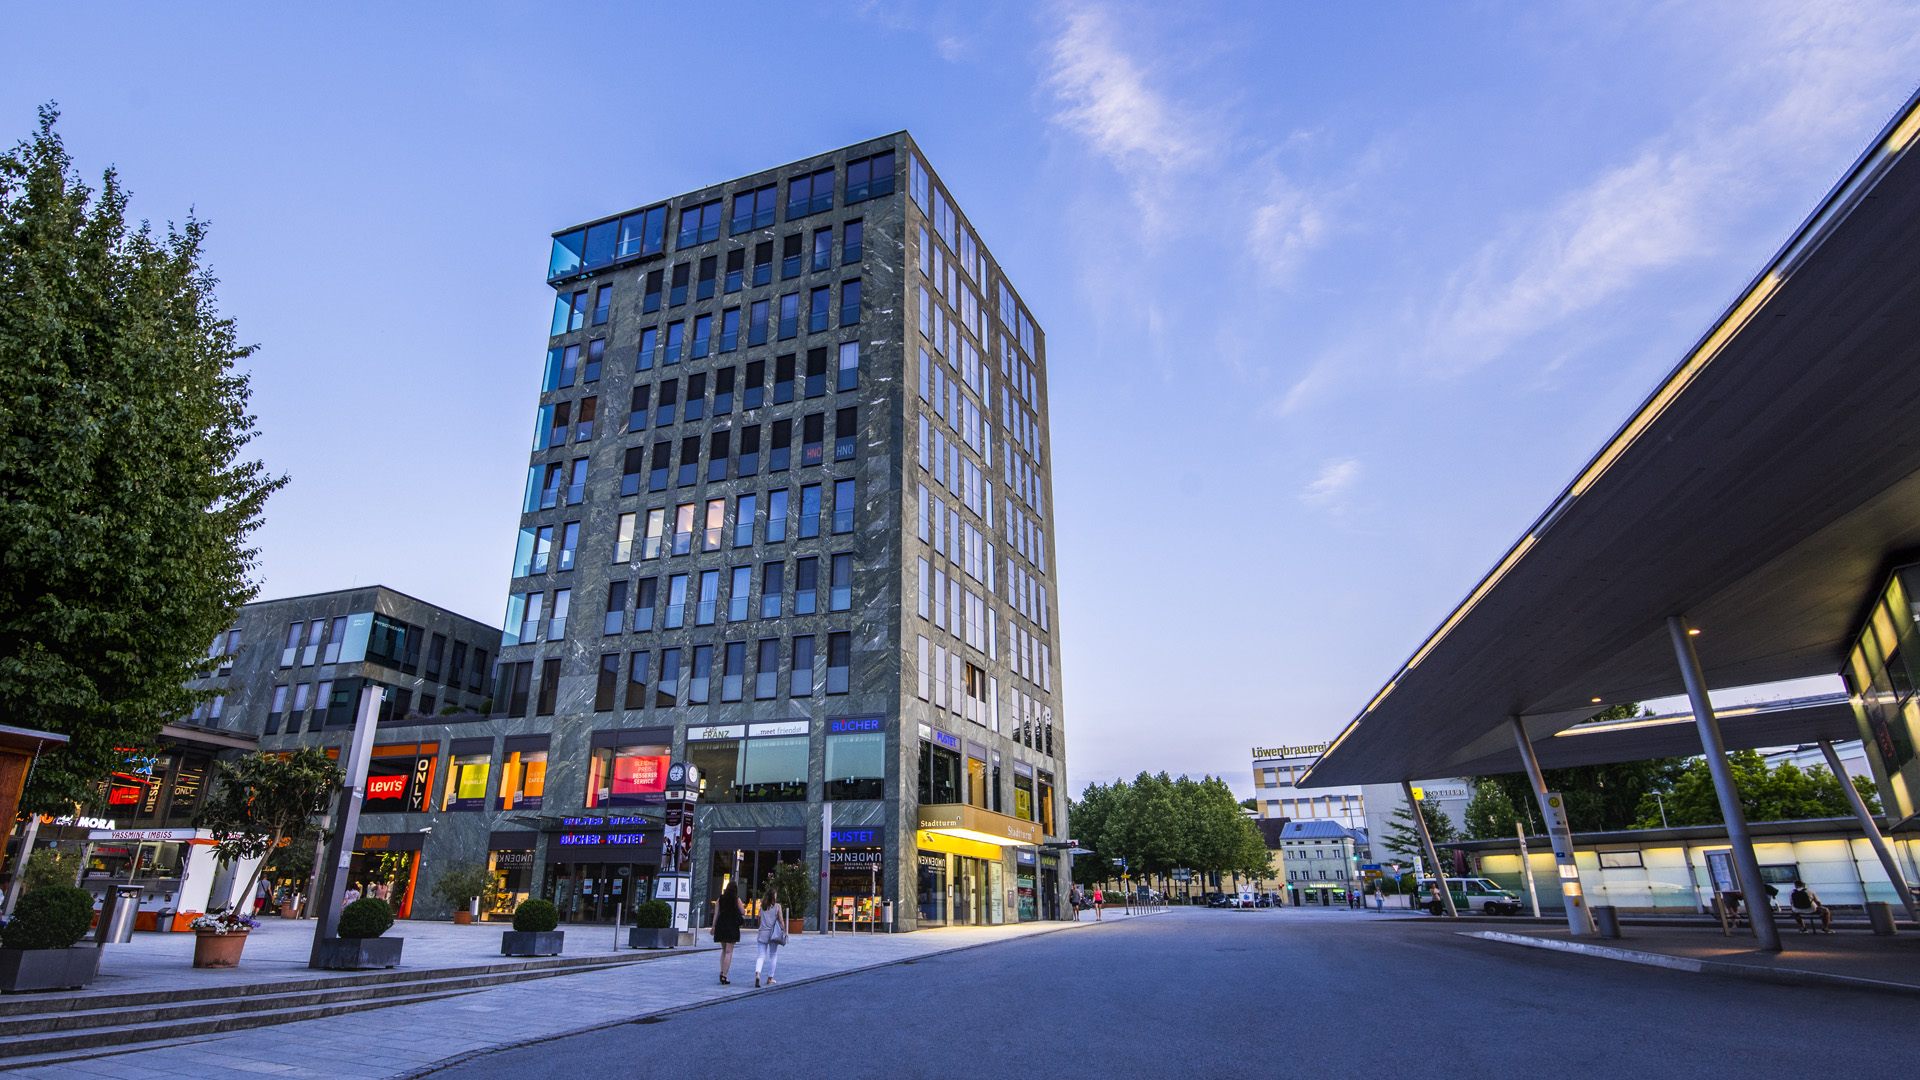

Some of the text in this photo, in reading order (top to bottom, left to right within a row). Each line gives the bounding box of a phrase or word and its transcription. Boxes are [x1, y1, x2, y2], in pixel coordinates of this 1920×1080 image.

[806, 446, 822, 460] HNO
[836, 444, 854, 457] HNO
[832, 719, 879, 732] BÜCHER
[702, 730, 730, 739] FRANZ
[1252, 741, 1327, 758] Löwenbrauerei
[634, 759, 658, 767] GLEICHER
[144, 778, 162, 813] DIESEL
[174, 787, 193, 795] ONLY
[77, 816, 116, 831] MORA
[920, 820, 957, 828] Stadtturm
[111, 831, 173, 839] YASSMINE IMBISS
[560, 832, 601, 845] BÜCHER
[1007, 825, 1033, 841] Stadtturm
[830, 852, 882, 862] UMDENKE
[917, 855, 946, 868] UMDENKEN
